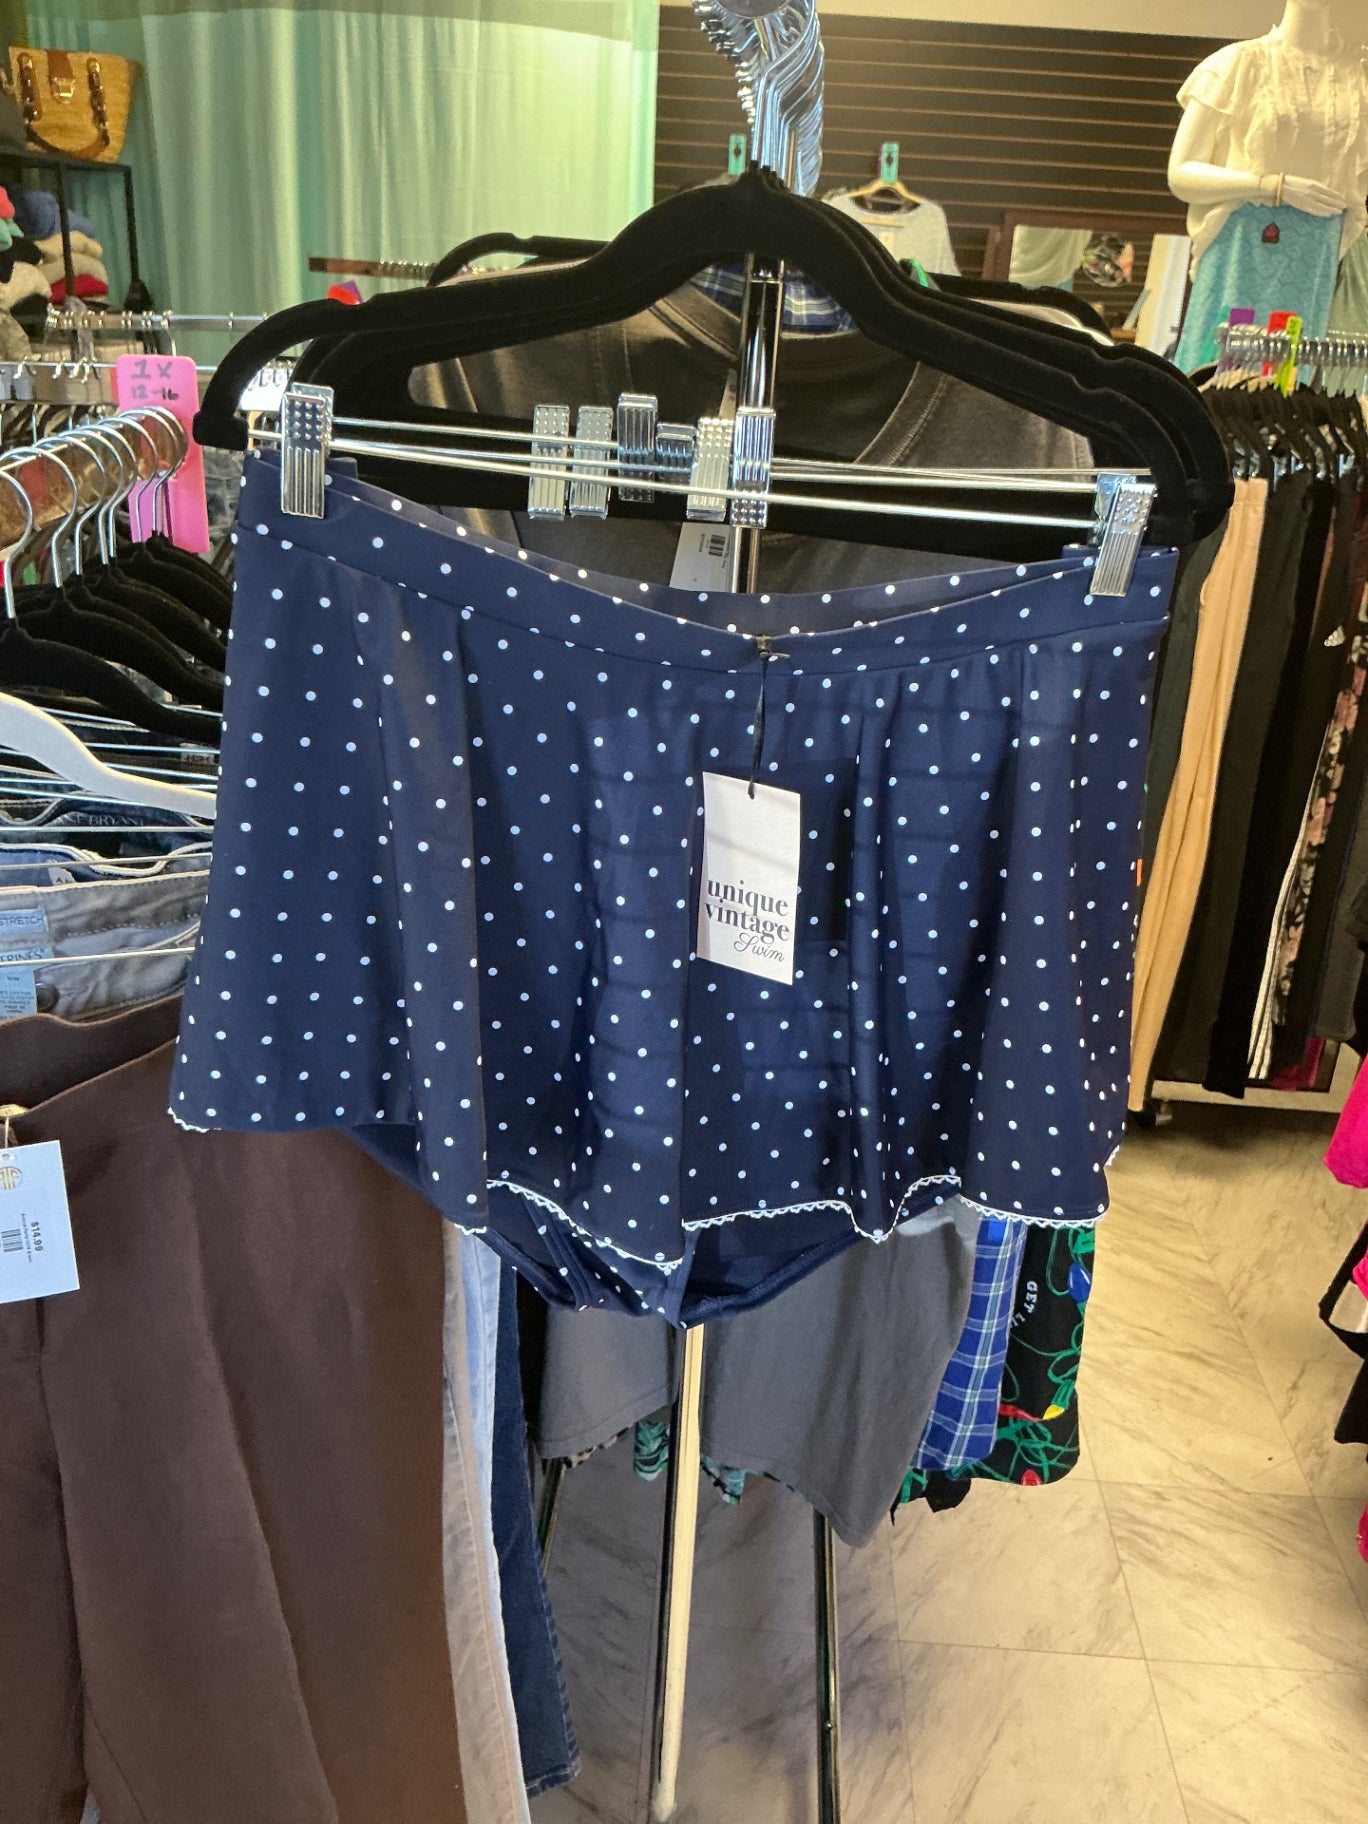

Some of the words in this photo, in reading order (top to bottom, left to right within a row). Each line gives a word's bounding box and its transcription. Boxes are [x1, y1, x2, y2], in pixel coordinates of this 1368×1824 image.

[708, 879, 788, 917] unique
[704, 898, 790, 945] vintage
[733, 932, 784, 962] Swim
[30, 1221, 43, 1252] $14.99
[1023, 1280, 1039, 1314] GET
